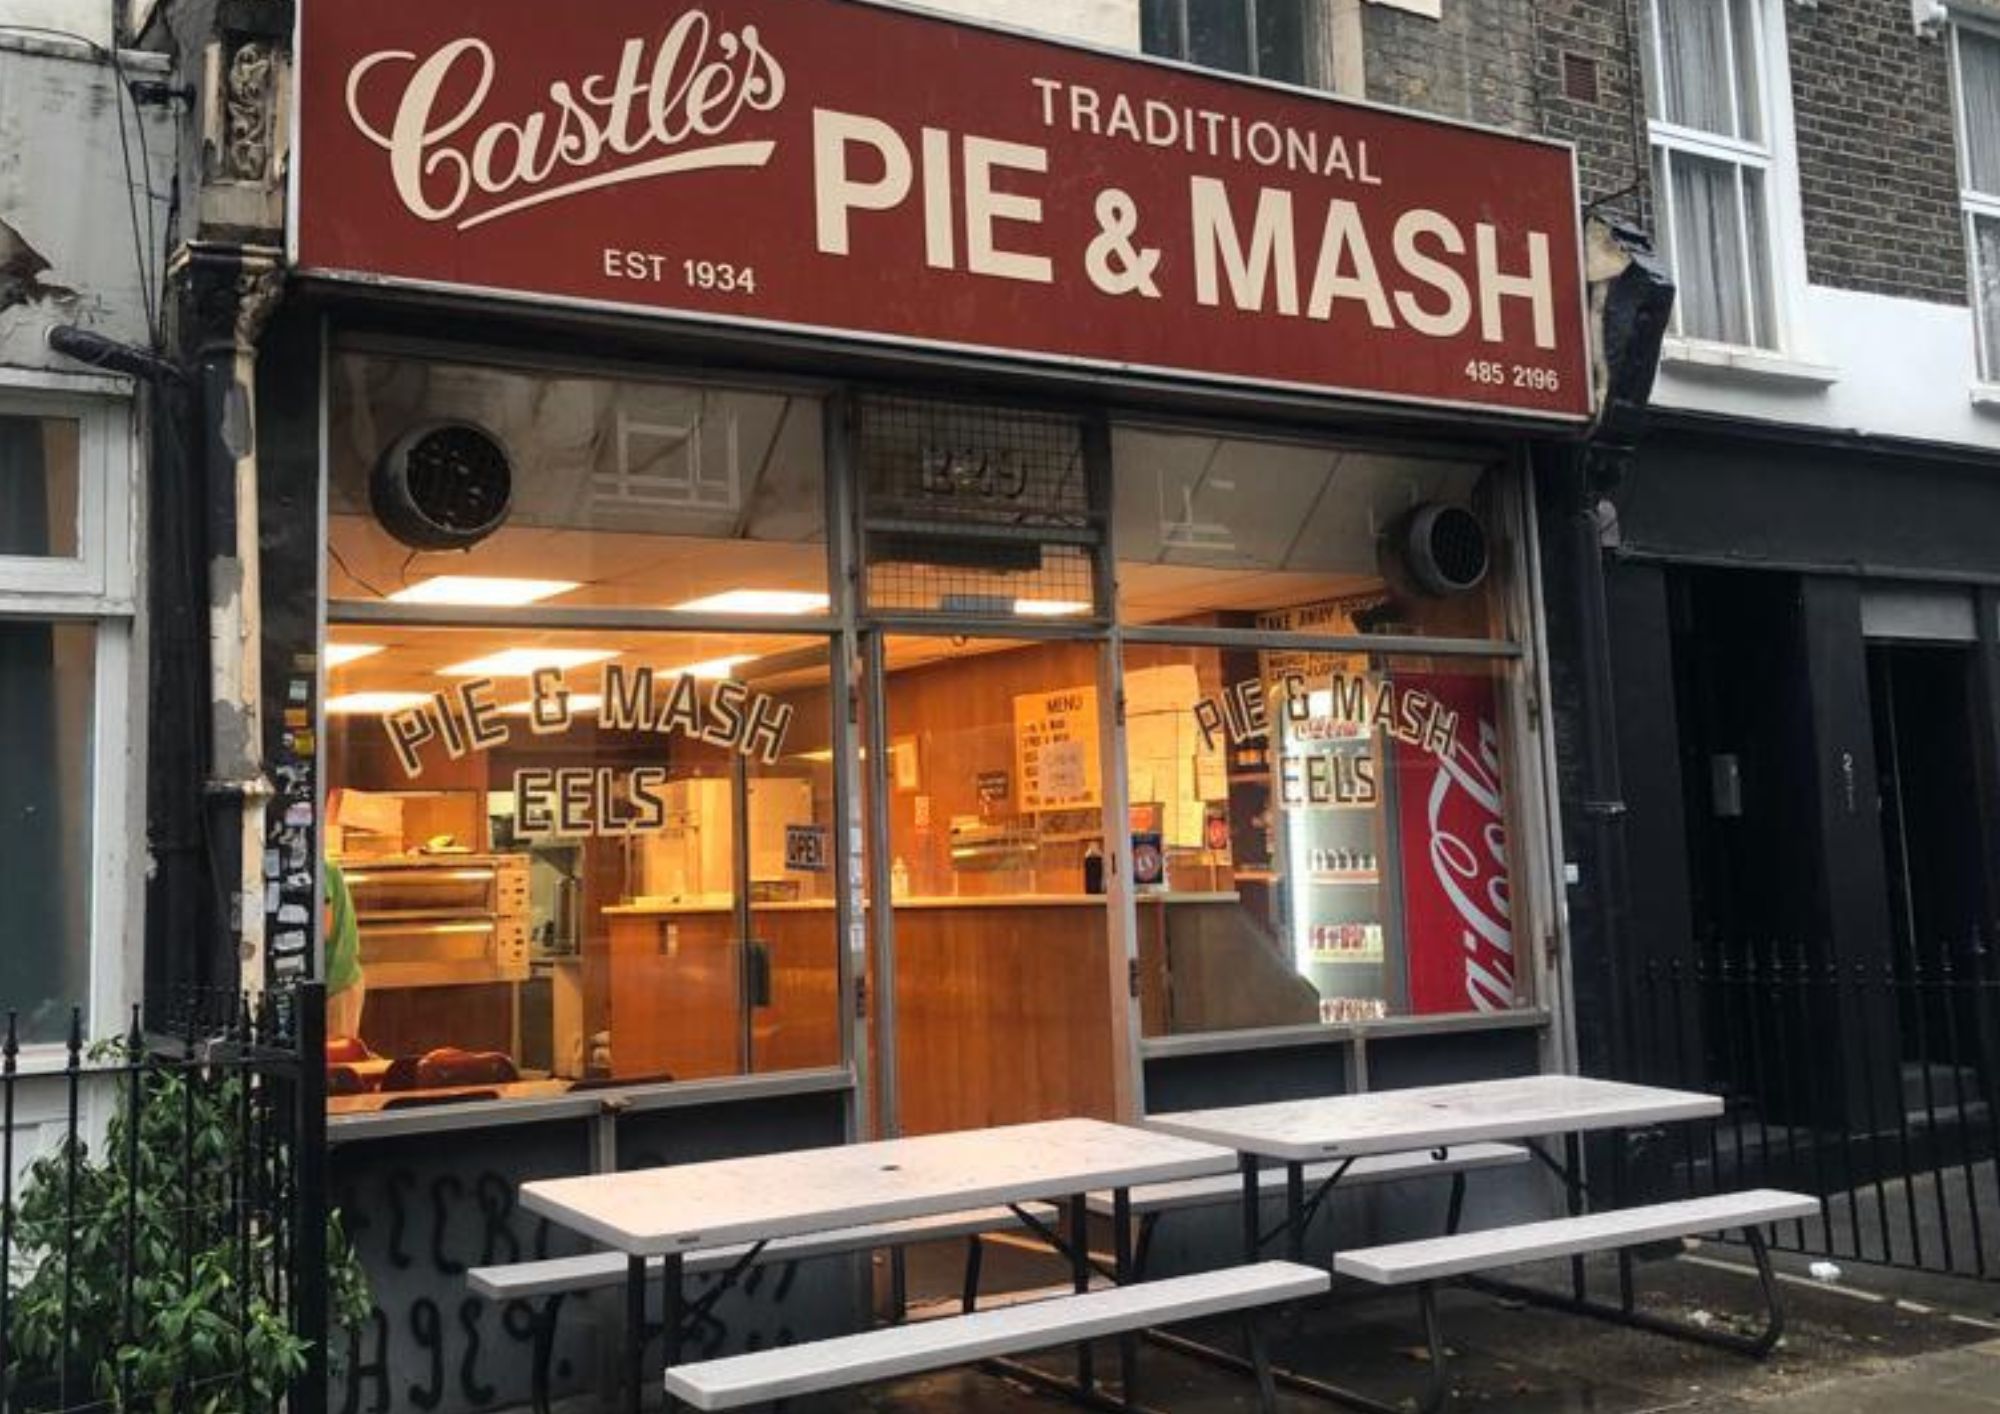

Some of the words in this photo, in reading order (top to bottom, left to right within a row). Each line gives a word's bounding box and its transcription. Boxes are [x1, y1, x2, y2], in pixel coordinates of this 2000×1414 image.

[346, 8, 785, 222] Castle's
[1032, 78, 1382, 185] TRADITIONAL
[813, 108, 1053, 283] PIE
[1084, 188, 1162, 299] &
[1190, 175, 1557, 350] MASH
[603, 248, 667, 282] EST
[682, 258, 756, 294] 1934
[1465, 359, 1505, 386] 485
[1513, 364, 1560, 393] 2196
[384, 677, 511, 780] PIE
[529, 665, 574, 735] &
[599, 663, 795, 767] MASH
[1046, 694, 1083, 713] MENU
[1194, 678, 1269, 752] PIE
[1285, 673, 1311, 722] &
[1331, 672, 1459, 760] MASH
[513, 766, 667, 839] EELS
[1277, 754, 1378, 808] EELS
[788, 831, 823, 863] OPEN
